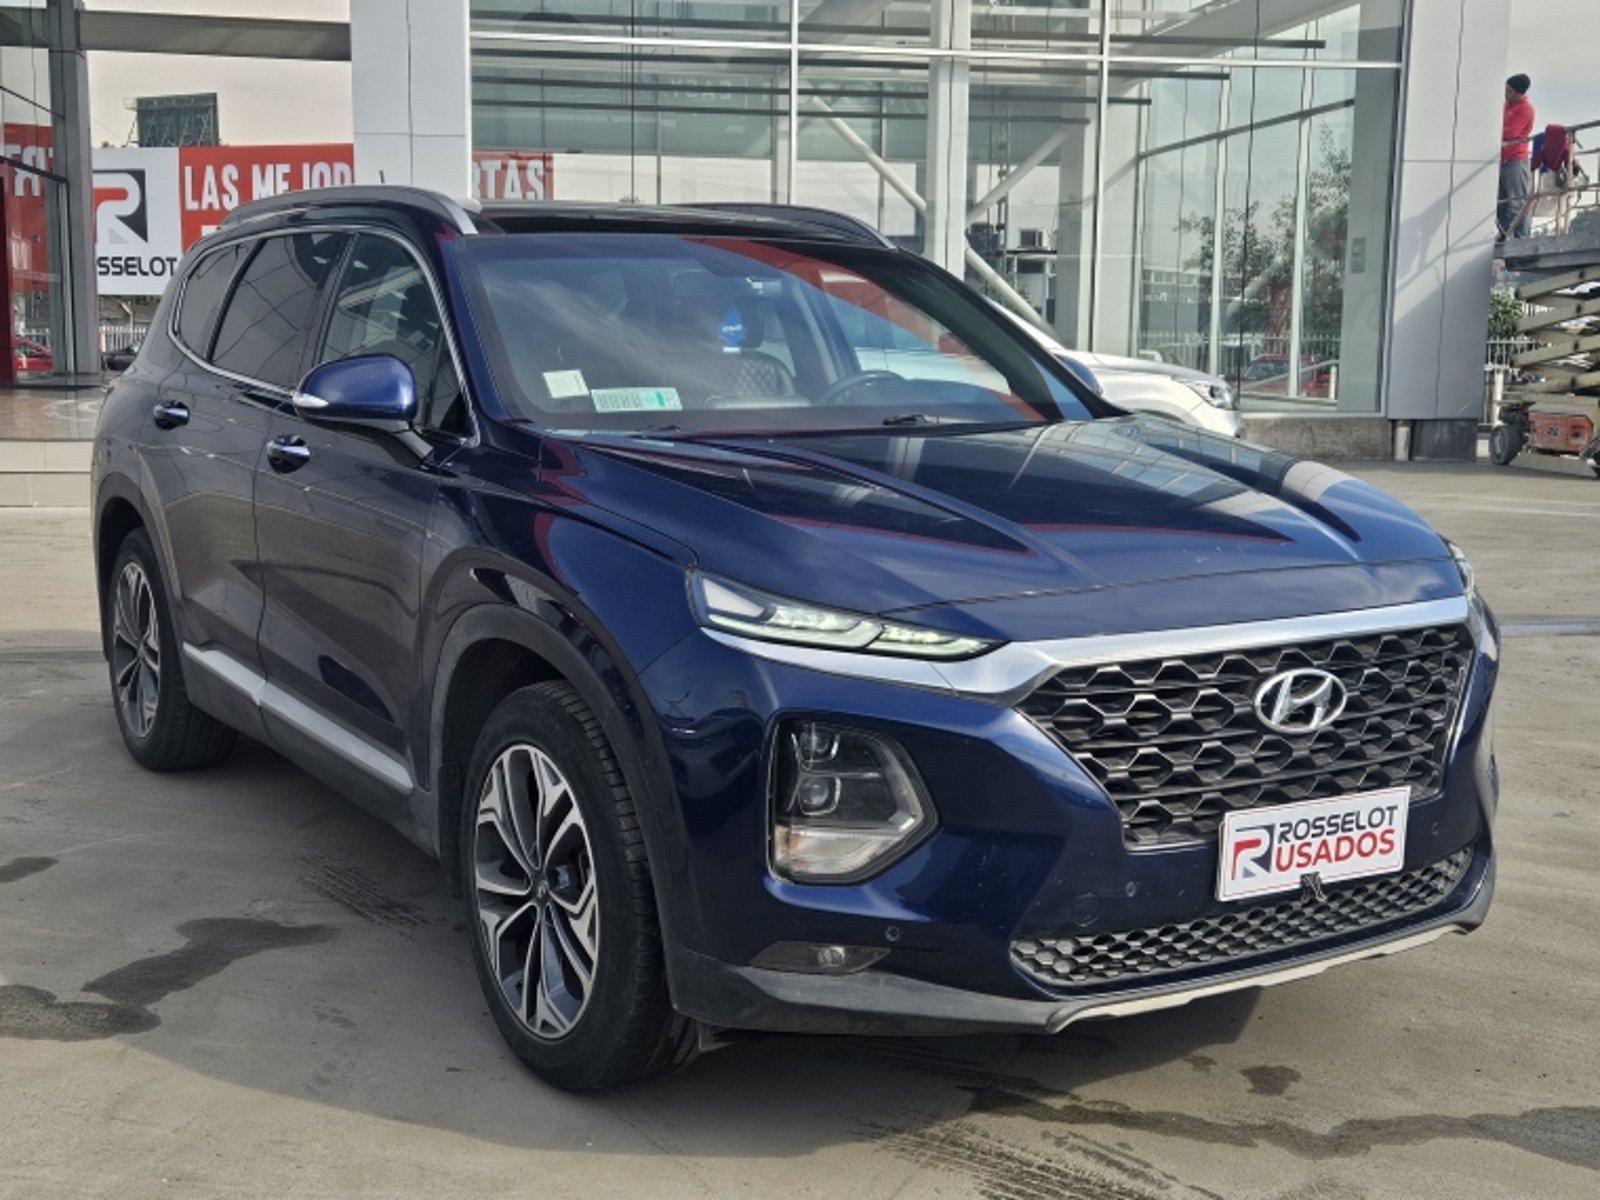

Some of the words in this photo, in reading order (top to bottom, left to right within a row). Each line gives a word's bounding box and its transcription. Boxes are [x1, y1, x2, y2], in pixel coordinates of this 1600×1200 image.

[184, 164, 239, 211] LAS
[97, 256, 177, 276] SSELOT
[1278, 805, 1398, 844] ROSSELOT
[1275, 828, 1395, 872] USADOS
